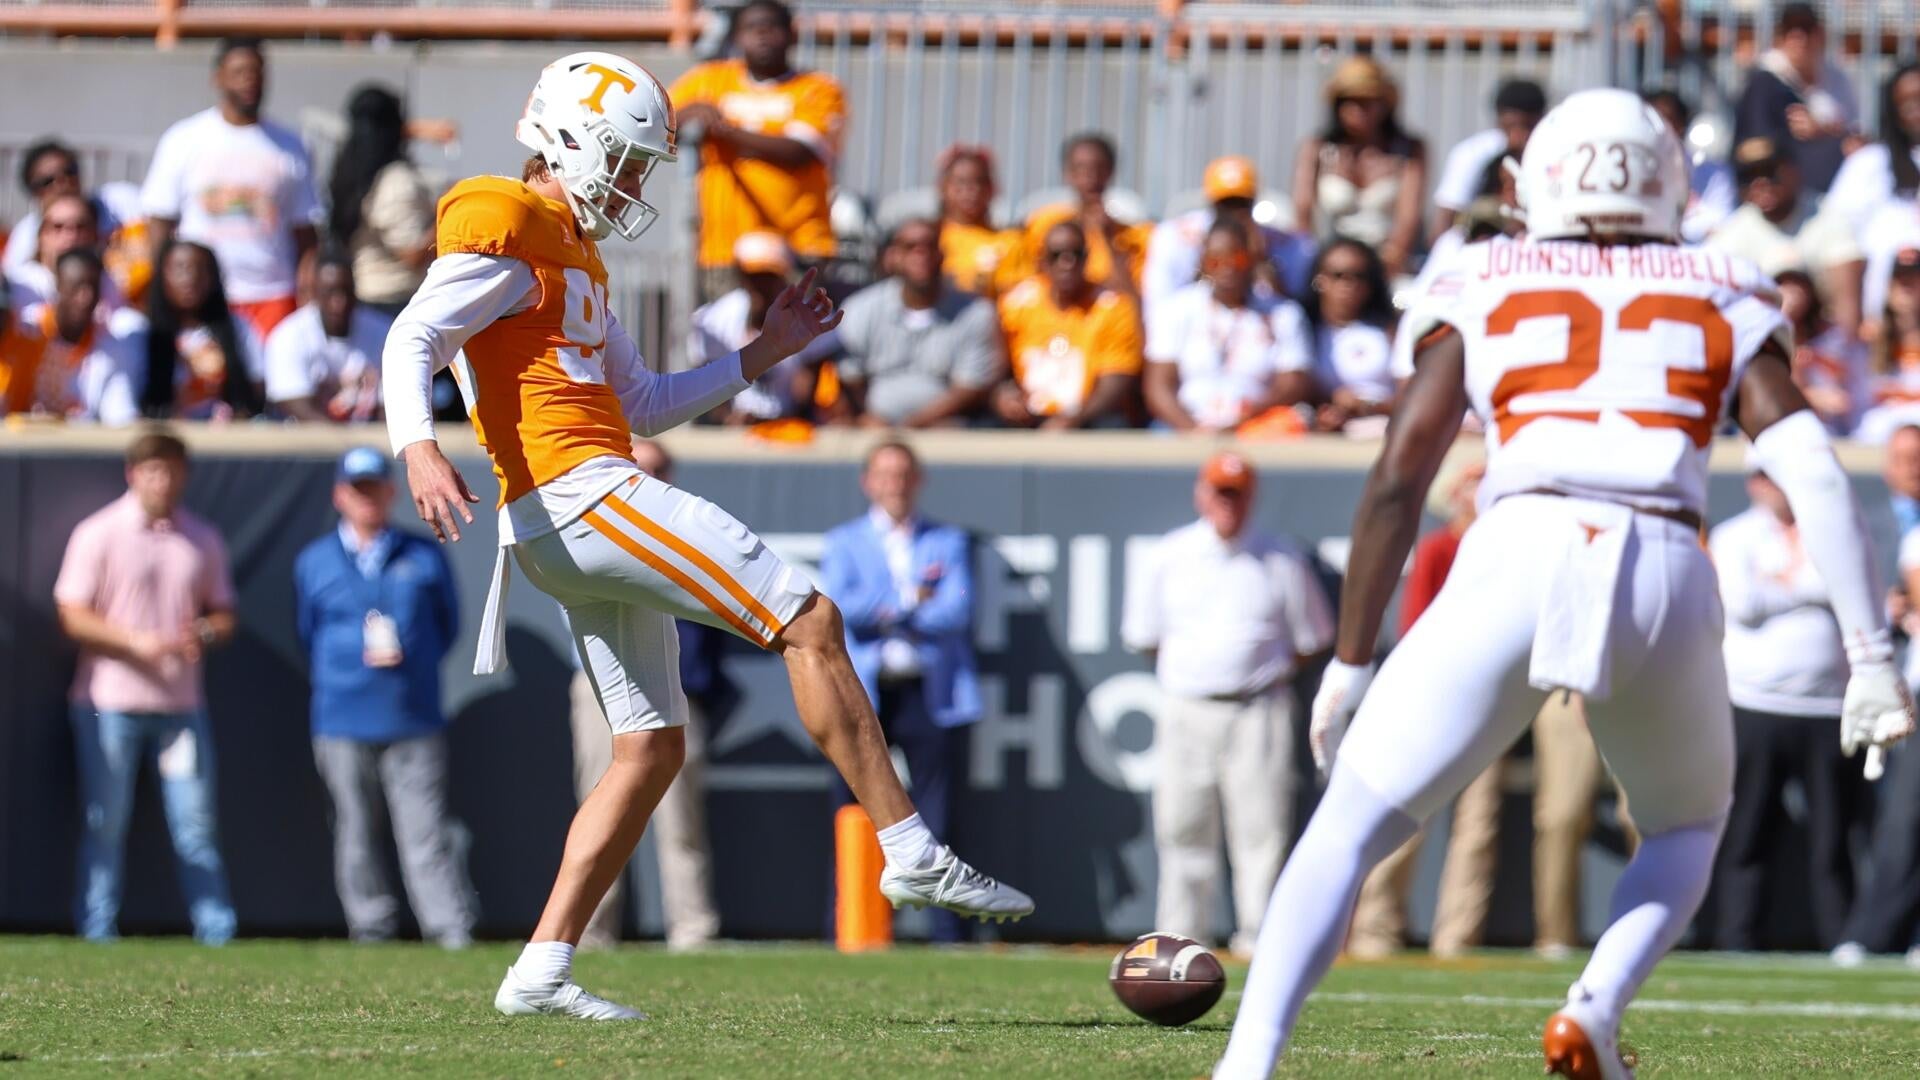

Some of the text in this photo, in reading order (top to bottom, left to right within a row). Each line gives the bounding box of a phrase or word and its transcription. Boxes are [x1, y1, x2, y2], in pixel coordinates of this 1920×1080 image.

[579, 63, 637, 115] T
[1577, 142, 1630, 191] 23
[1486, 290, 1733, 449] 23
